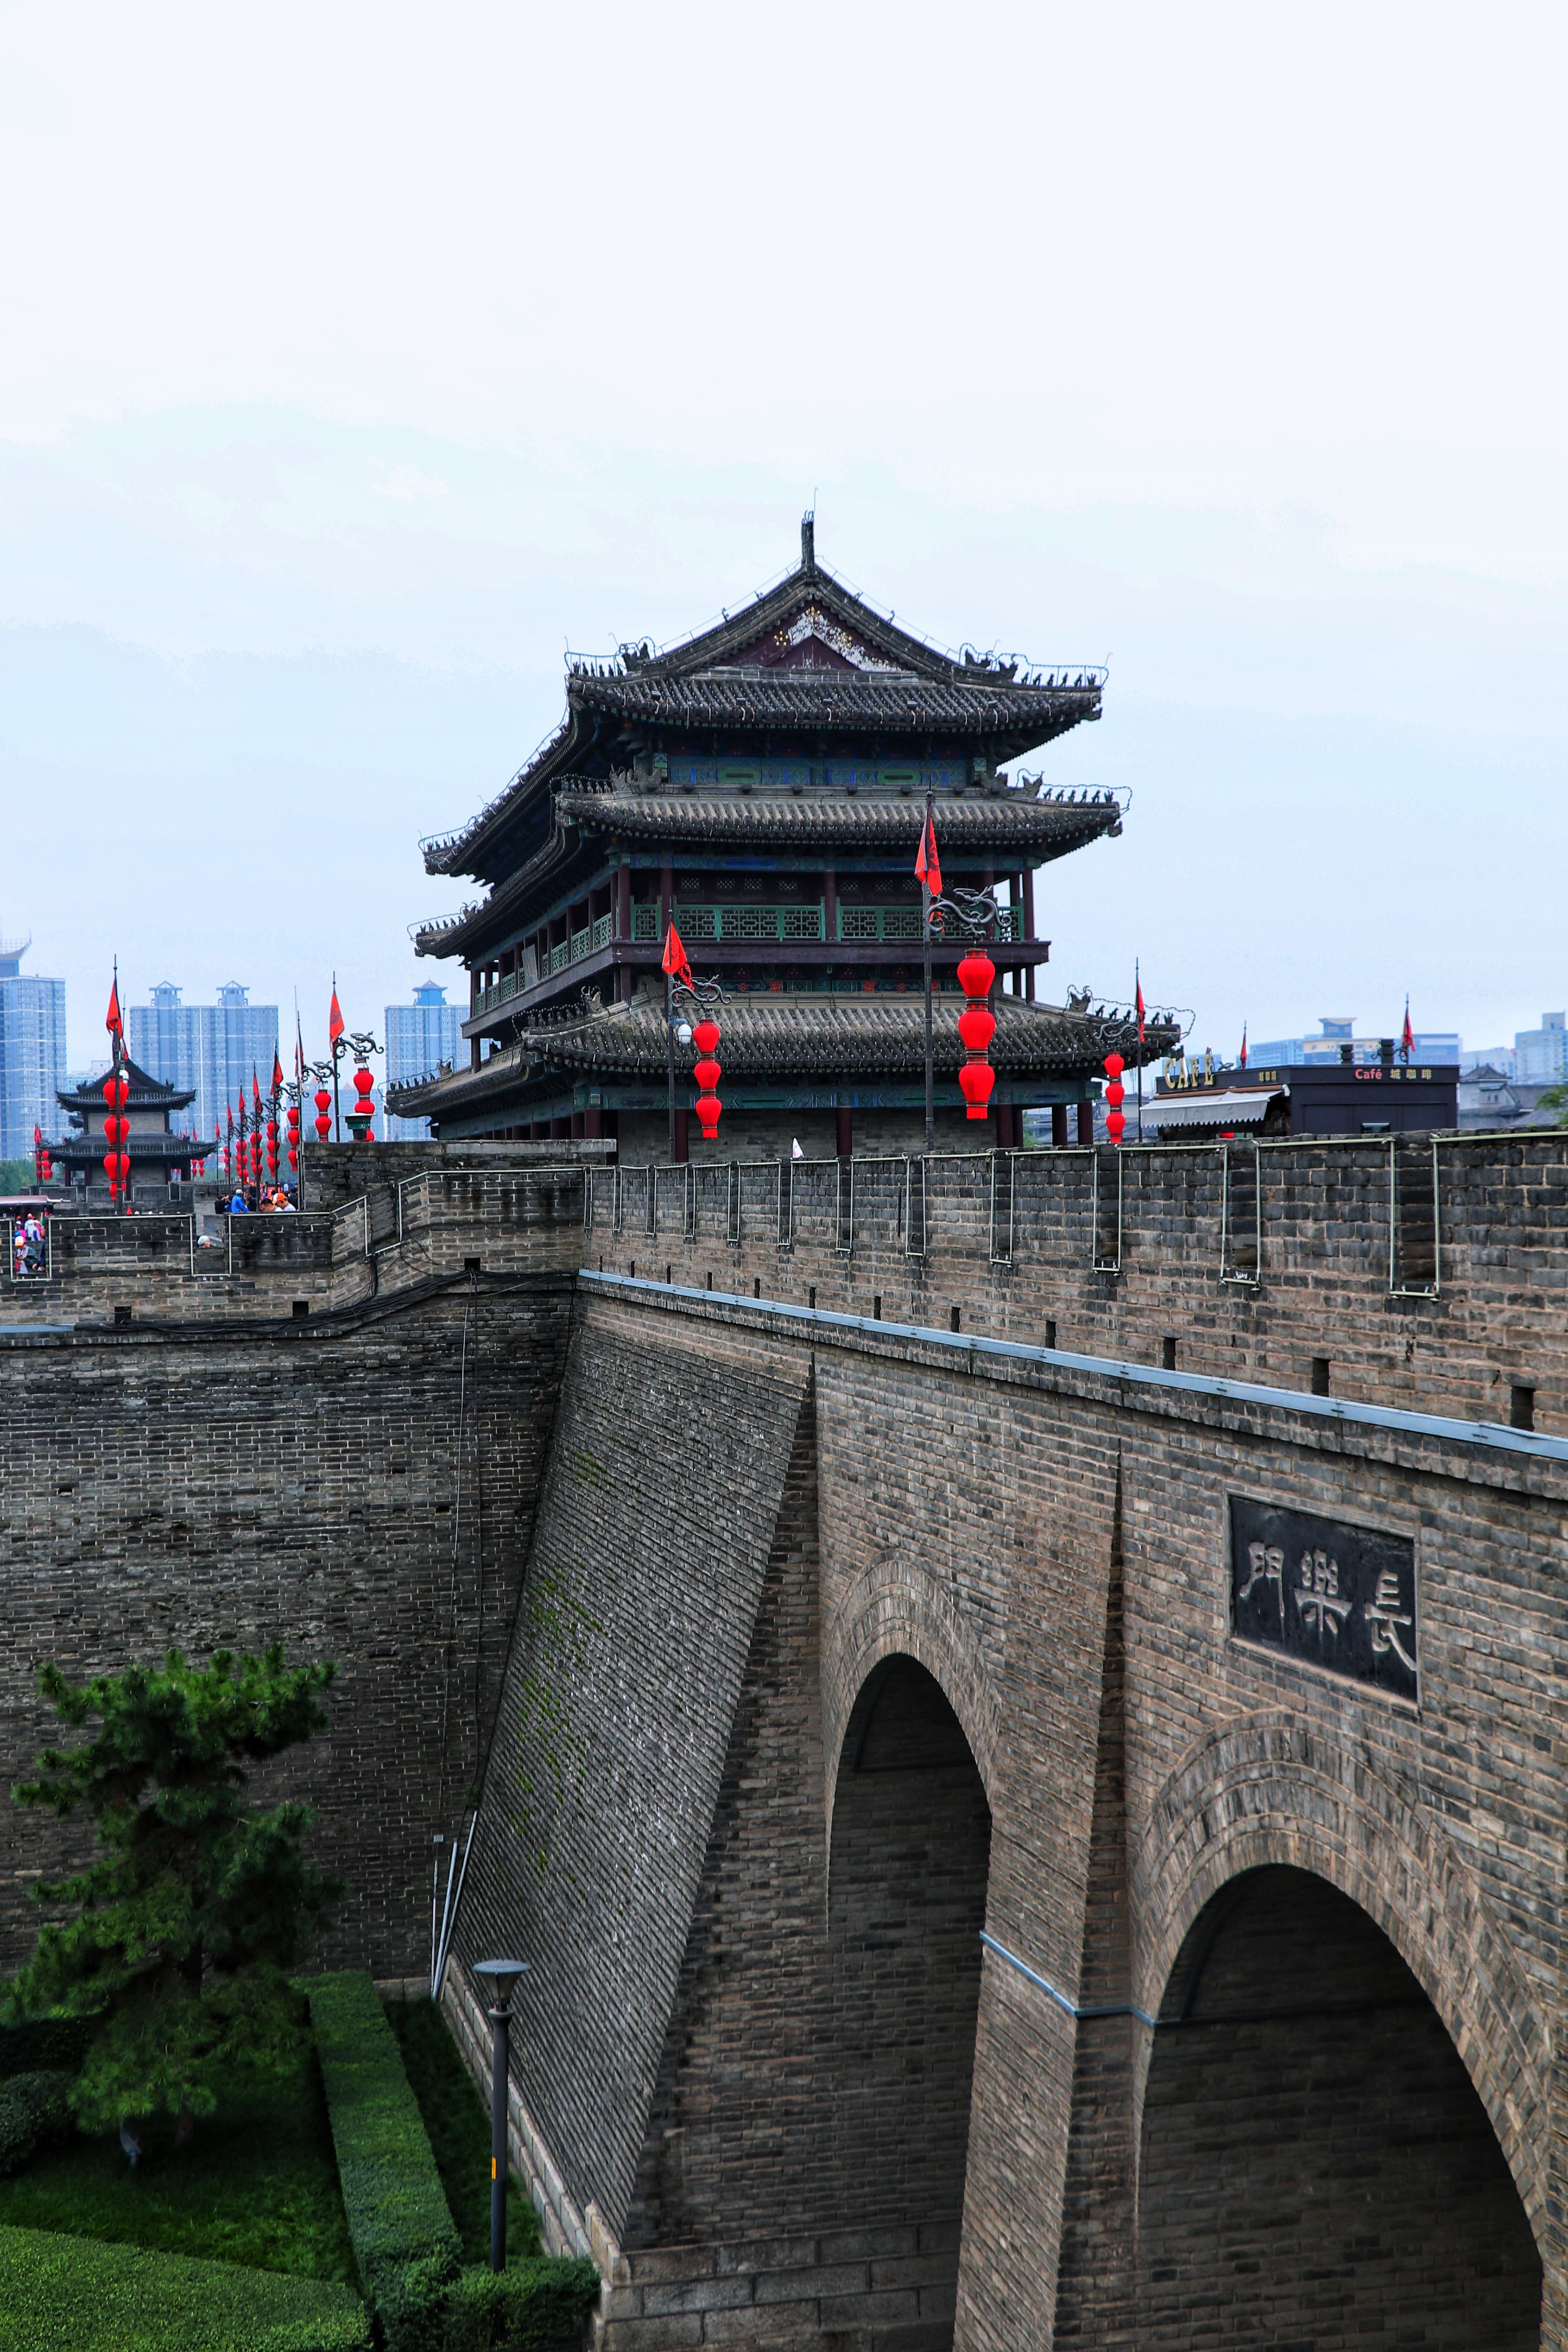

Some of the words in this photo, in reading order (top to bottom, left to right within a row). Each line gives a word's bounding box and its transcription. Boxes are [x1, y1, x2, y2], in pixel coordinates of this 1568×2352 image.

[1355, 1068, 1382, 1079] Café
[1390, 1068, 1432, 1079] 城咖啡
